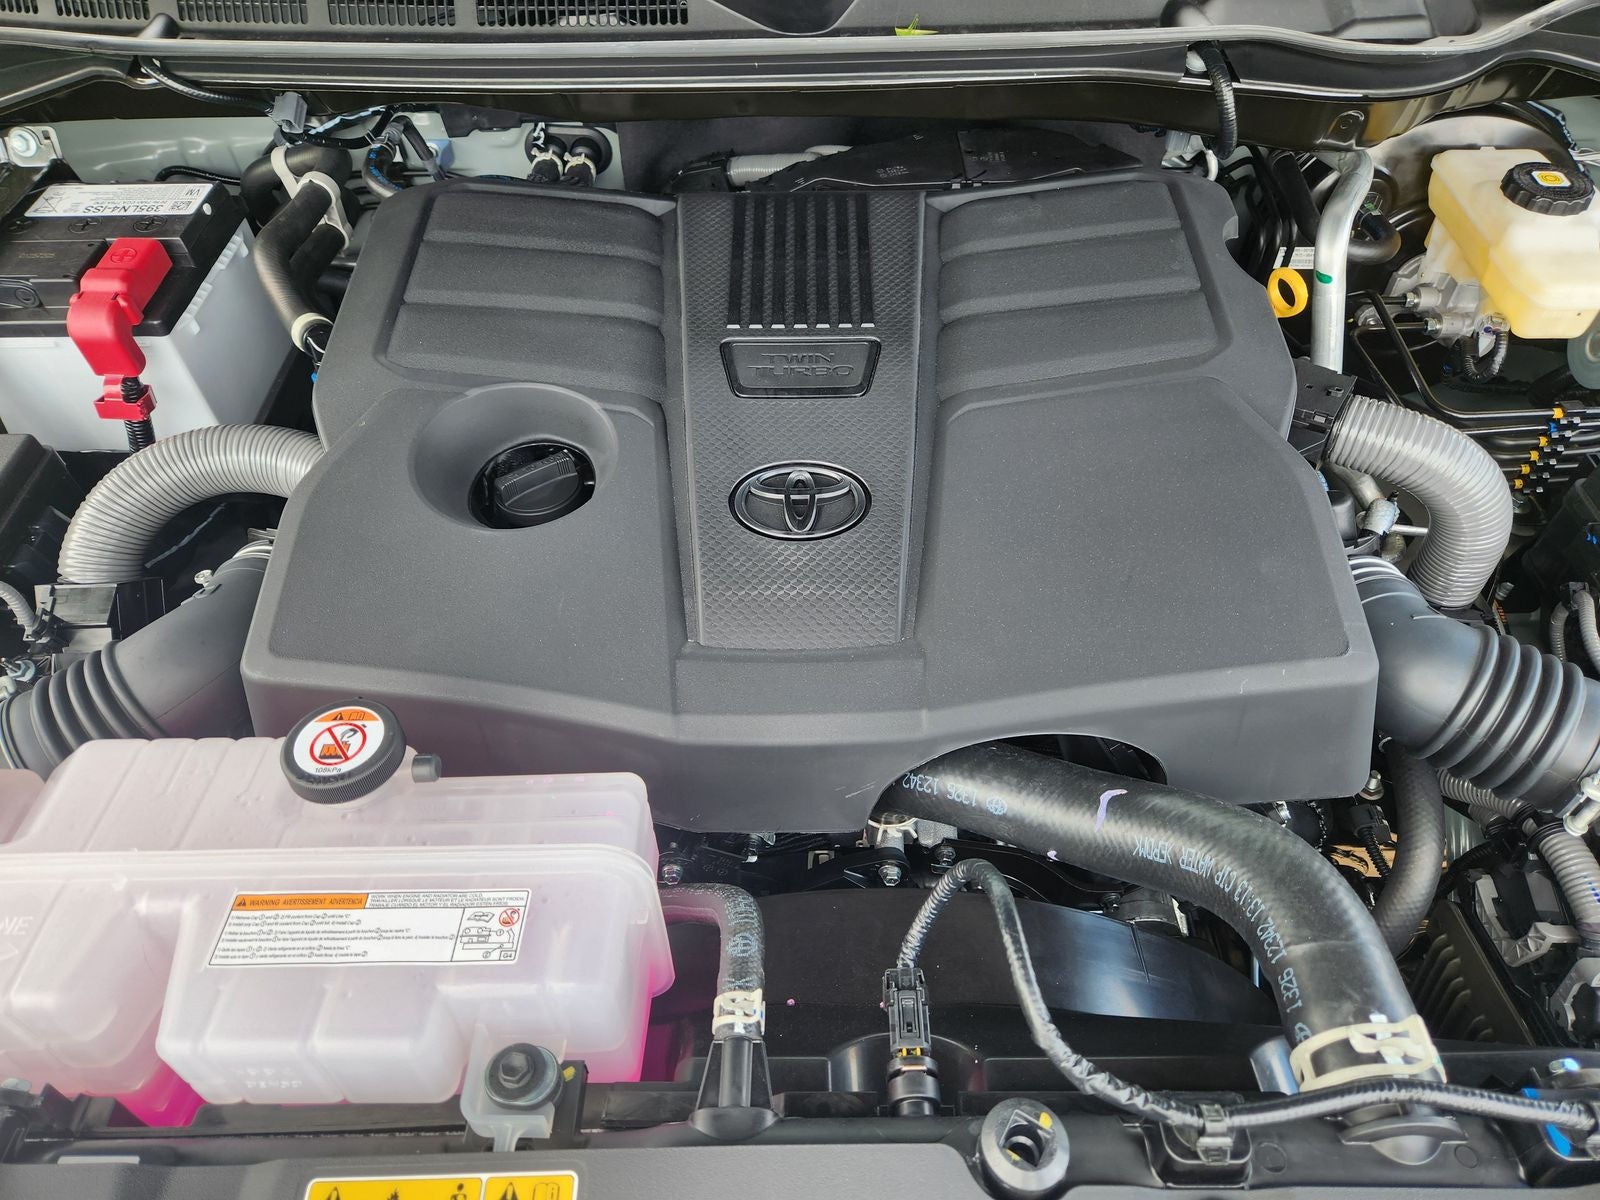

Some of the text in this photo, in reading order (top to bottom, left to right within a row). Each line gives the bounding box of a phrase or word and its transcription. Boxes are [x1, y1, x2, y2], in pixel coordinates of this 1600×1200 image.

[186, 188, 200, 197] VM
[83, 204, 164, 214] 395LN4-ISS
[761, 353, 835, 364] TWIN
[747, 364, 854, 377] TURBO
[902, 772, 979, 807] 1326 12342
[1179, 845, 1216, 879] WATER
[249, 899, 280, 907] WARNING
[282, 898, 326, 906] AVERTISSEMENT
[1233, 881, 1266, 922] 13:13
[0, 916, 33, 935] NE
[1256, 916, 1287, 964] 12342
[1278, 967, 1302, 1013] 1326
